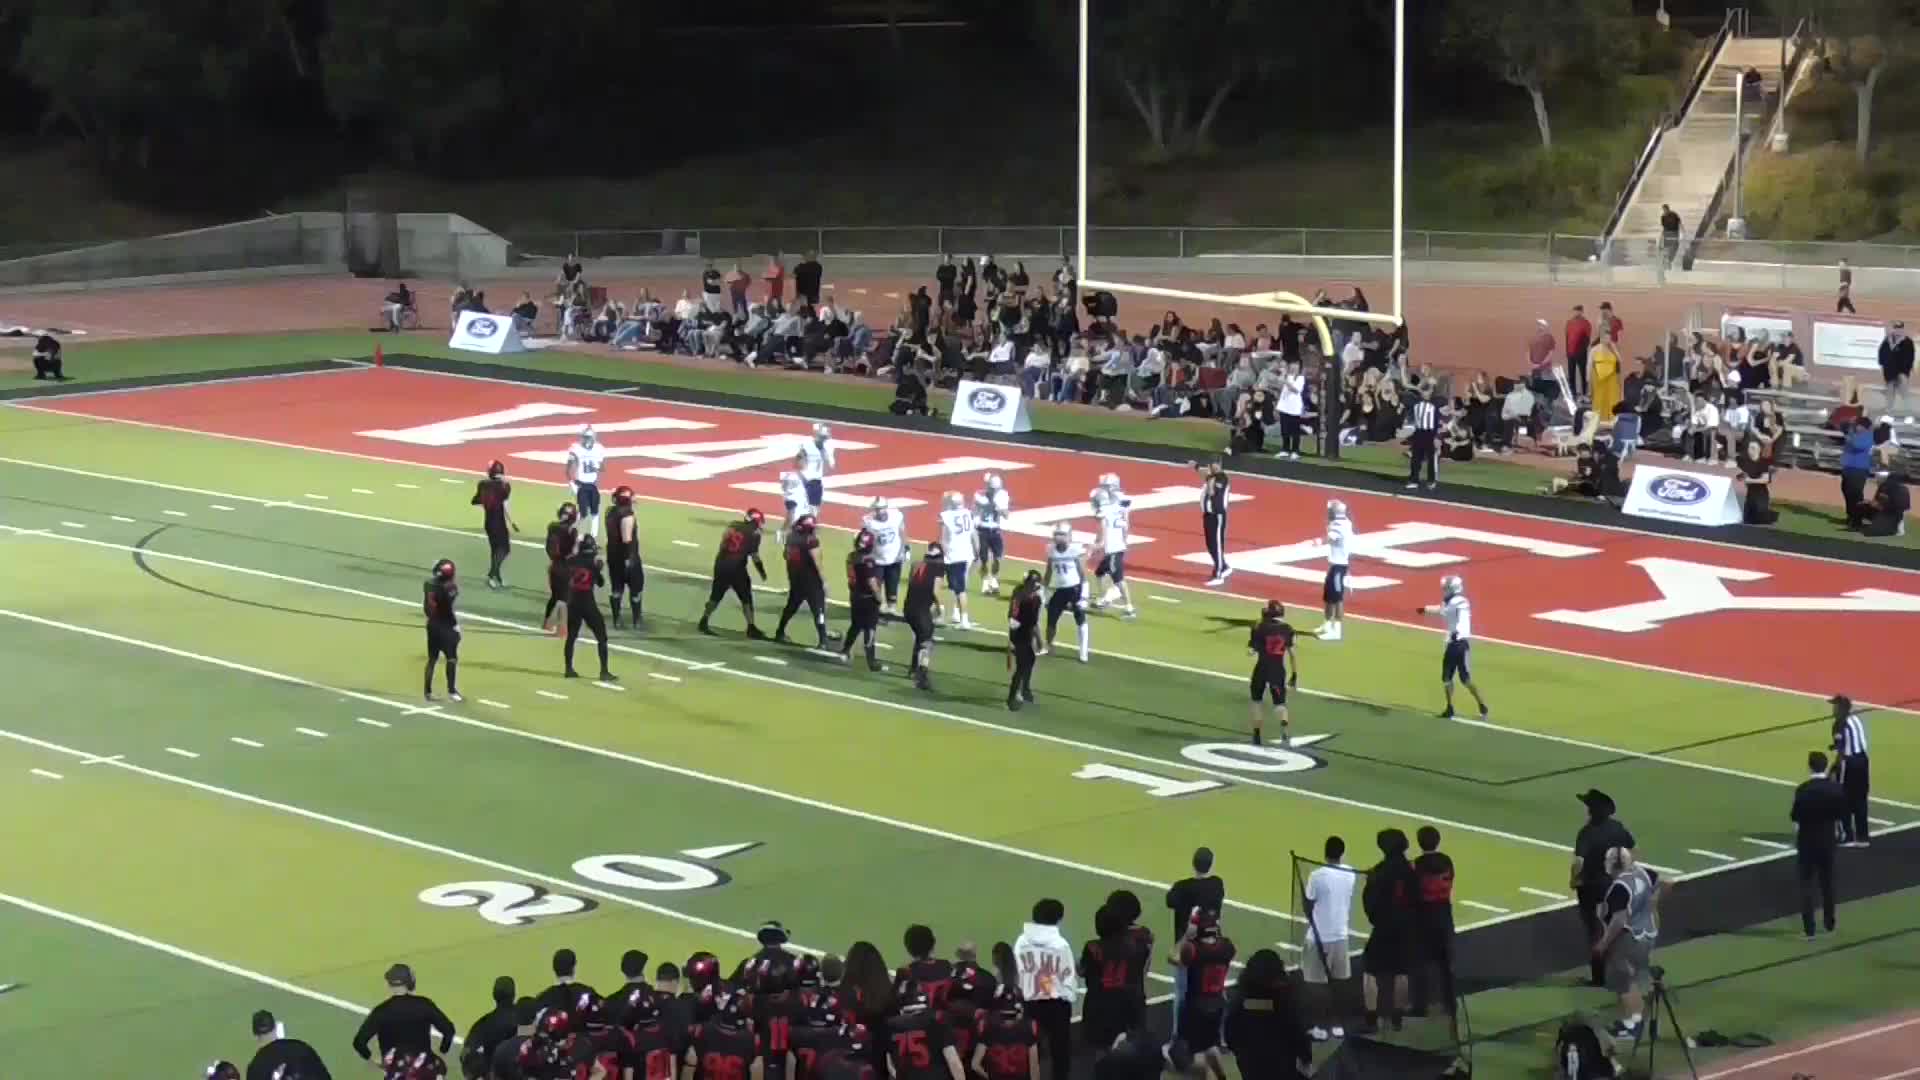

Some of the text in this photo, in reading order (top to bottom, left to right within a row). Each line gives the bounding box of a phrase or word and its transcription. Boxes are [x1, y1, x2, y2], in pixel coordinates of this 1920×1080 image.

[1657, 478, 1699, 500] Ford
[353, 402, 1920, 633] VALLEY
[954, 513, 971, 535] 50
